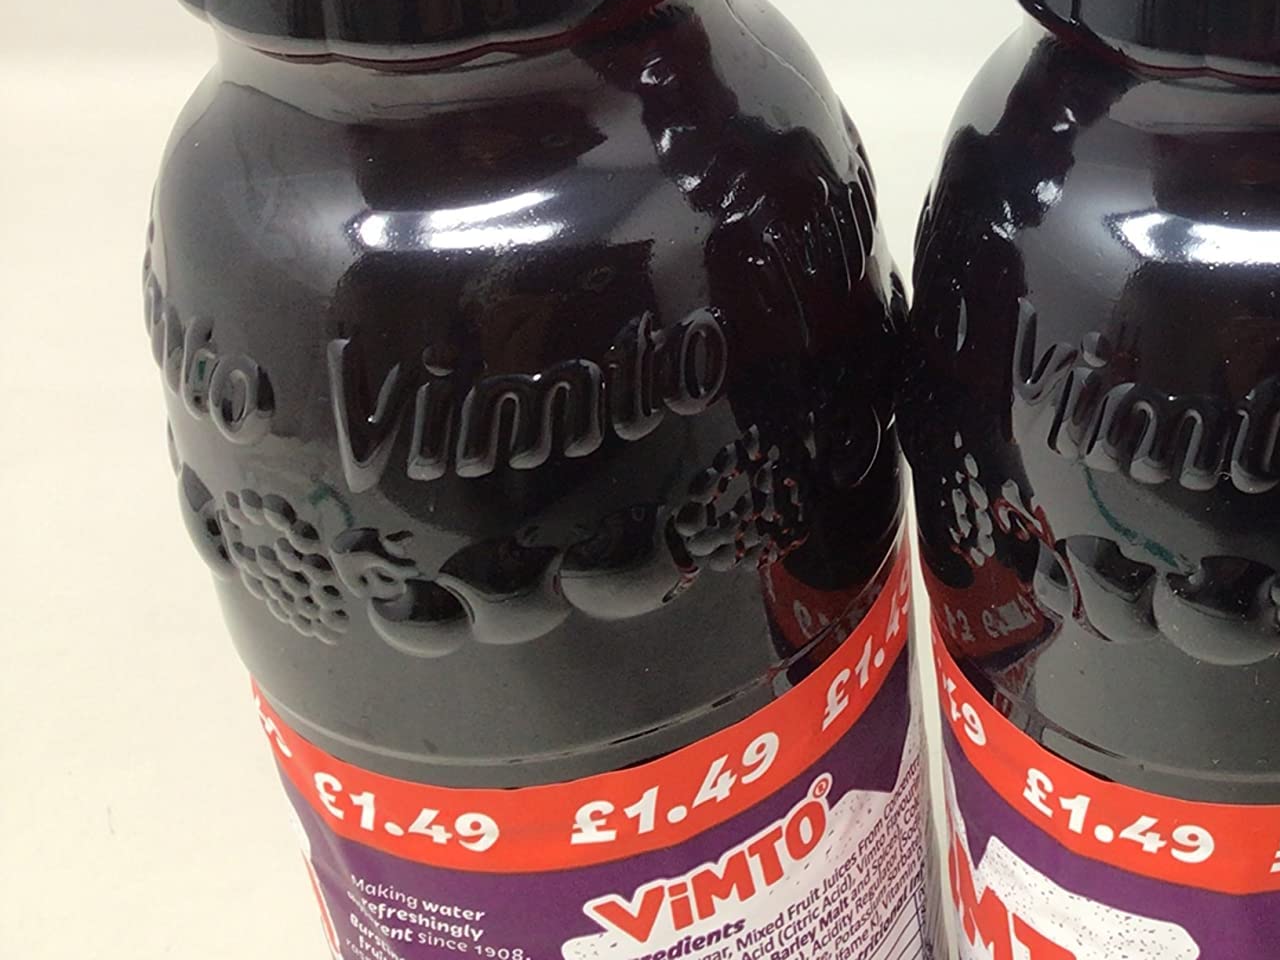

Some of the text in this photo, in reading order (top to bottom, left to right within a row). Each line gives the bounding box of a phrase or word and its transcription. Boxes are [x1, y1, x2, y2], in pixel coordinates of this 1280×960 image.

[326, 307, 729, 494] Vimto
[313, 771, 500, 851] £1.49
[570, 731, 781, 845] £1.49
[1022, 767, 1216, 864] £1.49
[350, 874, 420, 910] Making
[422, 898, 486, 922] water
[592, 800, 827, 944] ViMTO
[736, 912, 784, 952] Mixed
[787, 887, 821, 921] Fruit
[822, 853, 857, 895] Juices
[857, 819, 884, 857] From
[360, 897, 485, 942] refreshingly
[417, 930, 468, 953] since
[741, 927, 774, 960] Acid
[778, 906, 821, 948] (Citric
[769, 926, 817, 960] Barley
[818, 896, 851, 932] Malt
[811, 911, 855, 956] Acidity
